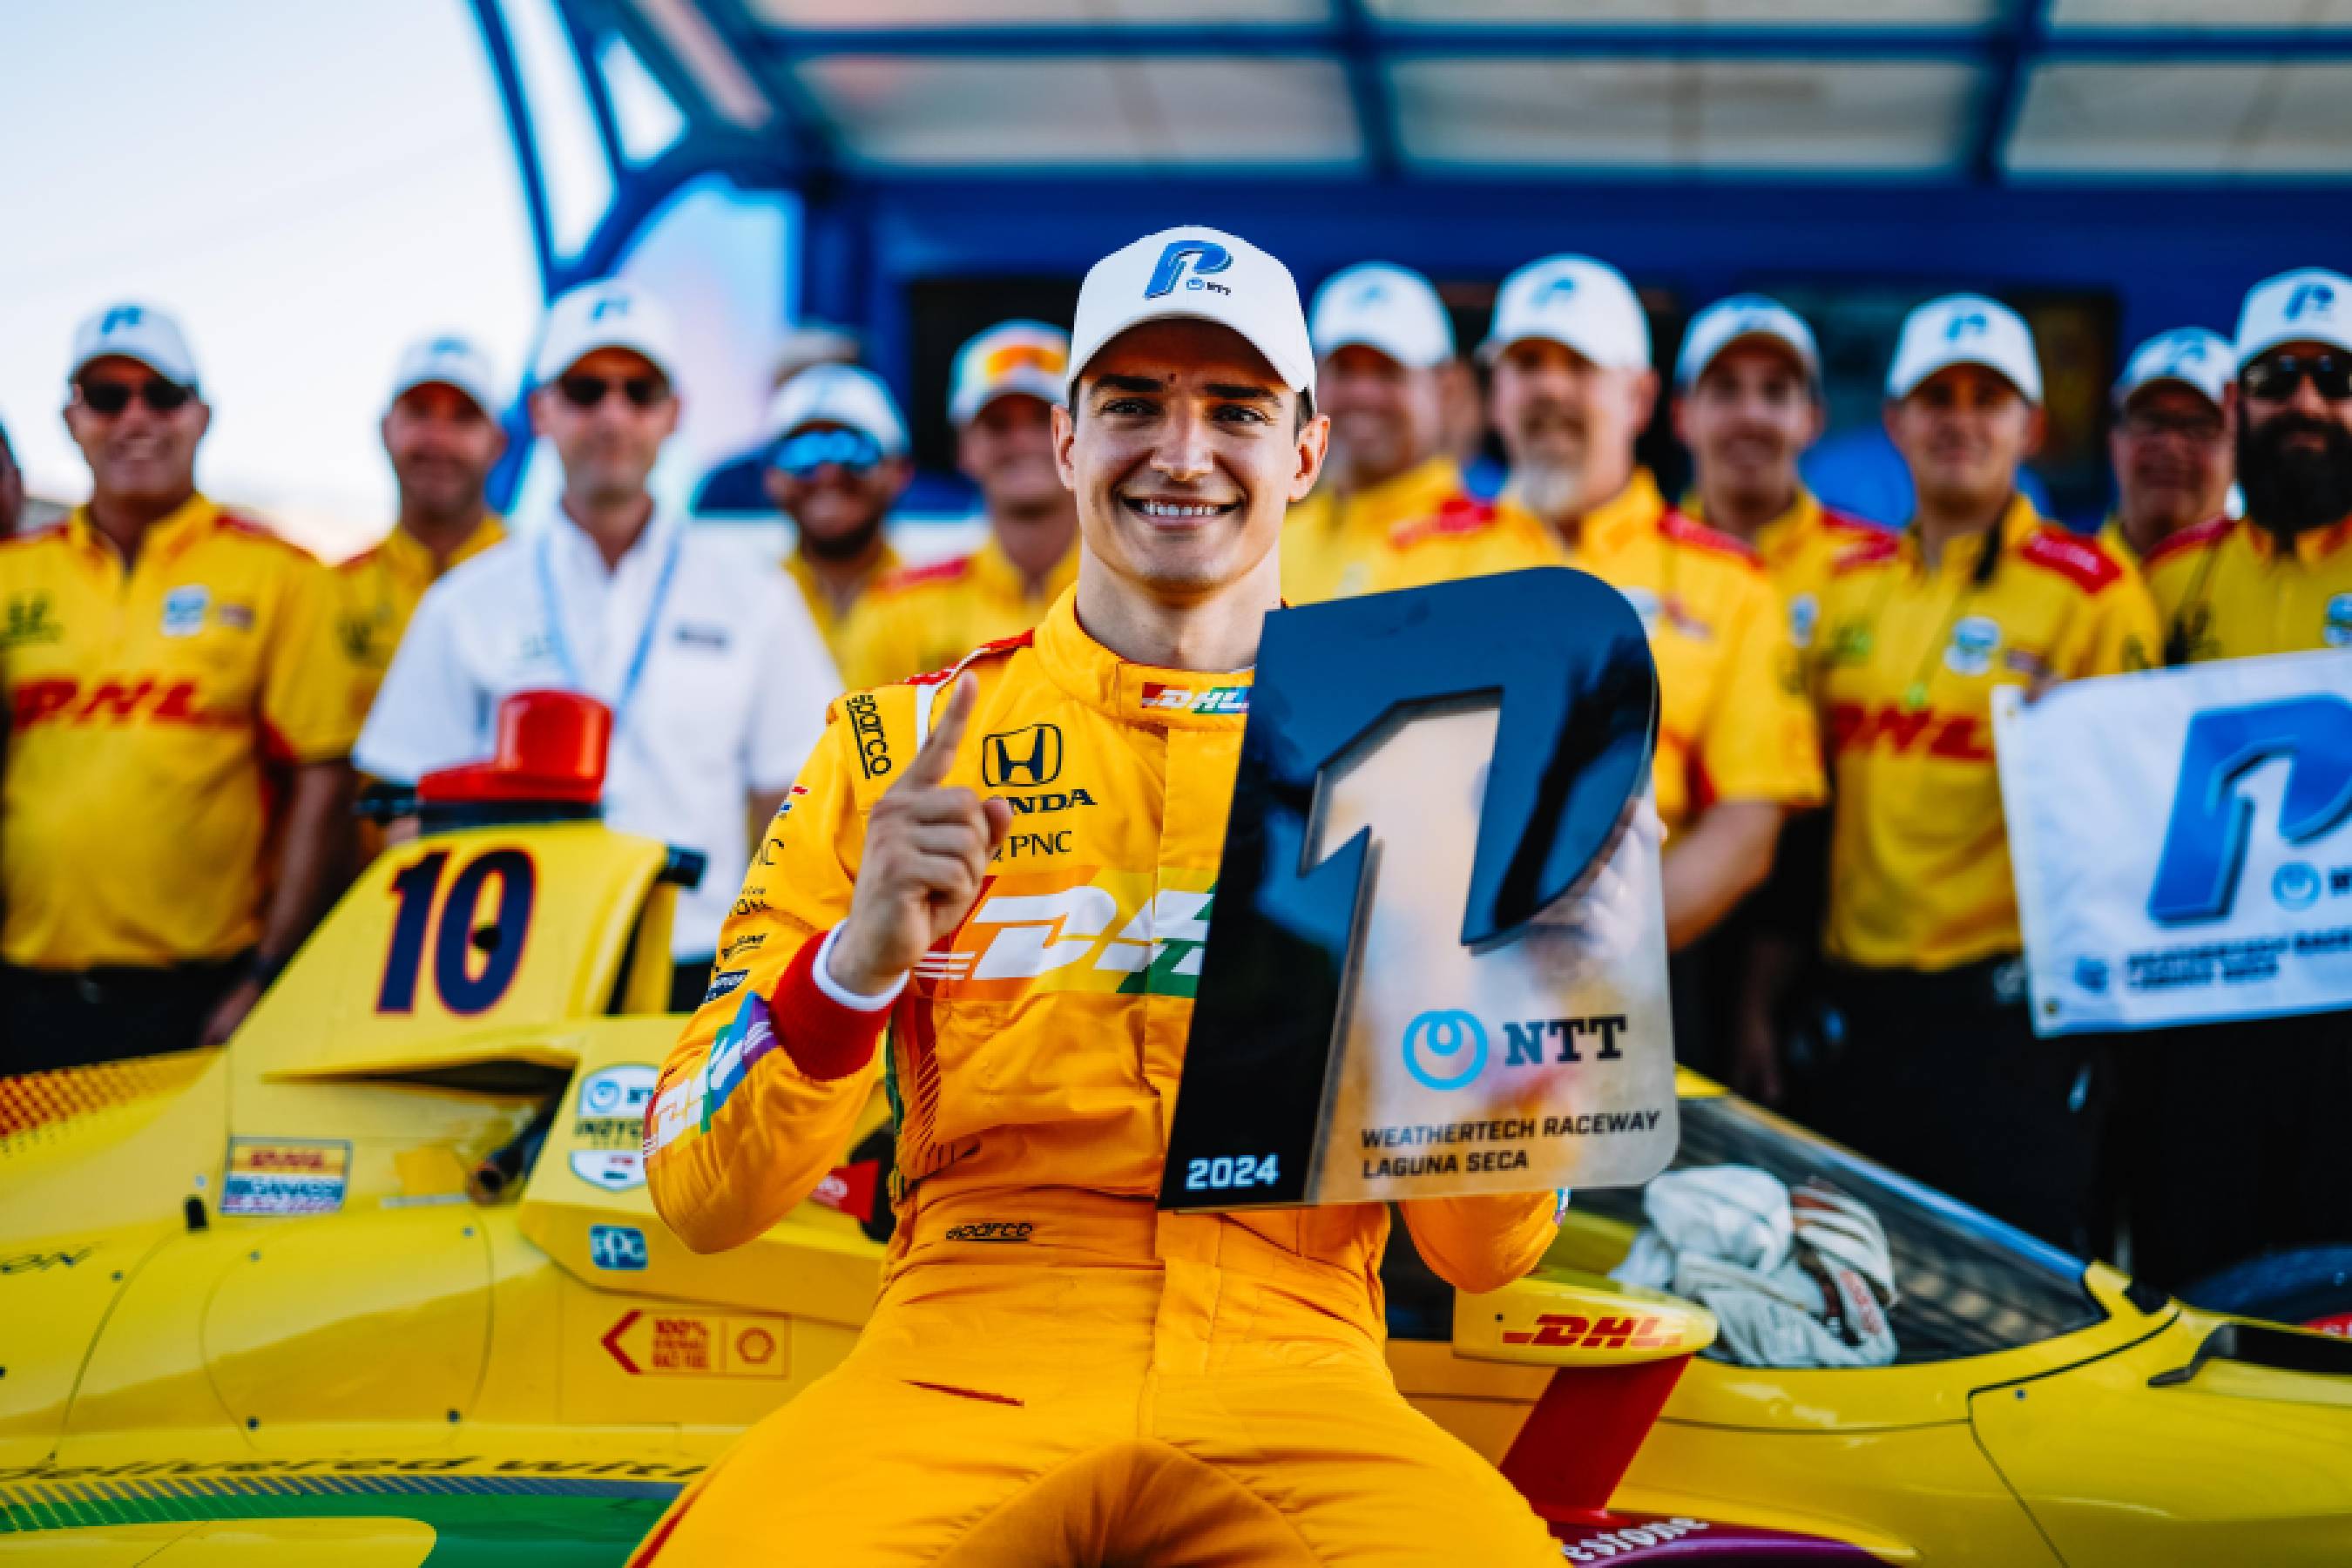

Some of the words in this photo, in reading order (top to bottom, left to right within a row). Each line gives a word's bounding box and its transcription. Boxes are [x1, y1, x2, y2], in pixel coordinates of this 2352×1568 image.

[1155, 688, 1250, 710] DHL
[845, 694, 892, 779] sparco
[1006, 788, 1098, 814] NDA
[1008, 829, 1072, 858] PNC
[375, 847, 537, 1016] 10
[971, 886, 1215, 982] DH
[1504, 1016, 1625, 1066] NTT
[1362, 1119, 1535, 1148] WEATHERTECH
[1543, 1110, 1659, 1137] RACEWAY
[1186, 1153, 1281, 1191] 2024
[1362, 1154, 1458, 1179] LAGUNA
[1466, 1149, 1529, 1173] SECA
[945, 1221, 1033, 1241] sparco
[1531, 1314, 1662, 1349] DHL
[1561, 1517, 1710, 1562] estone
